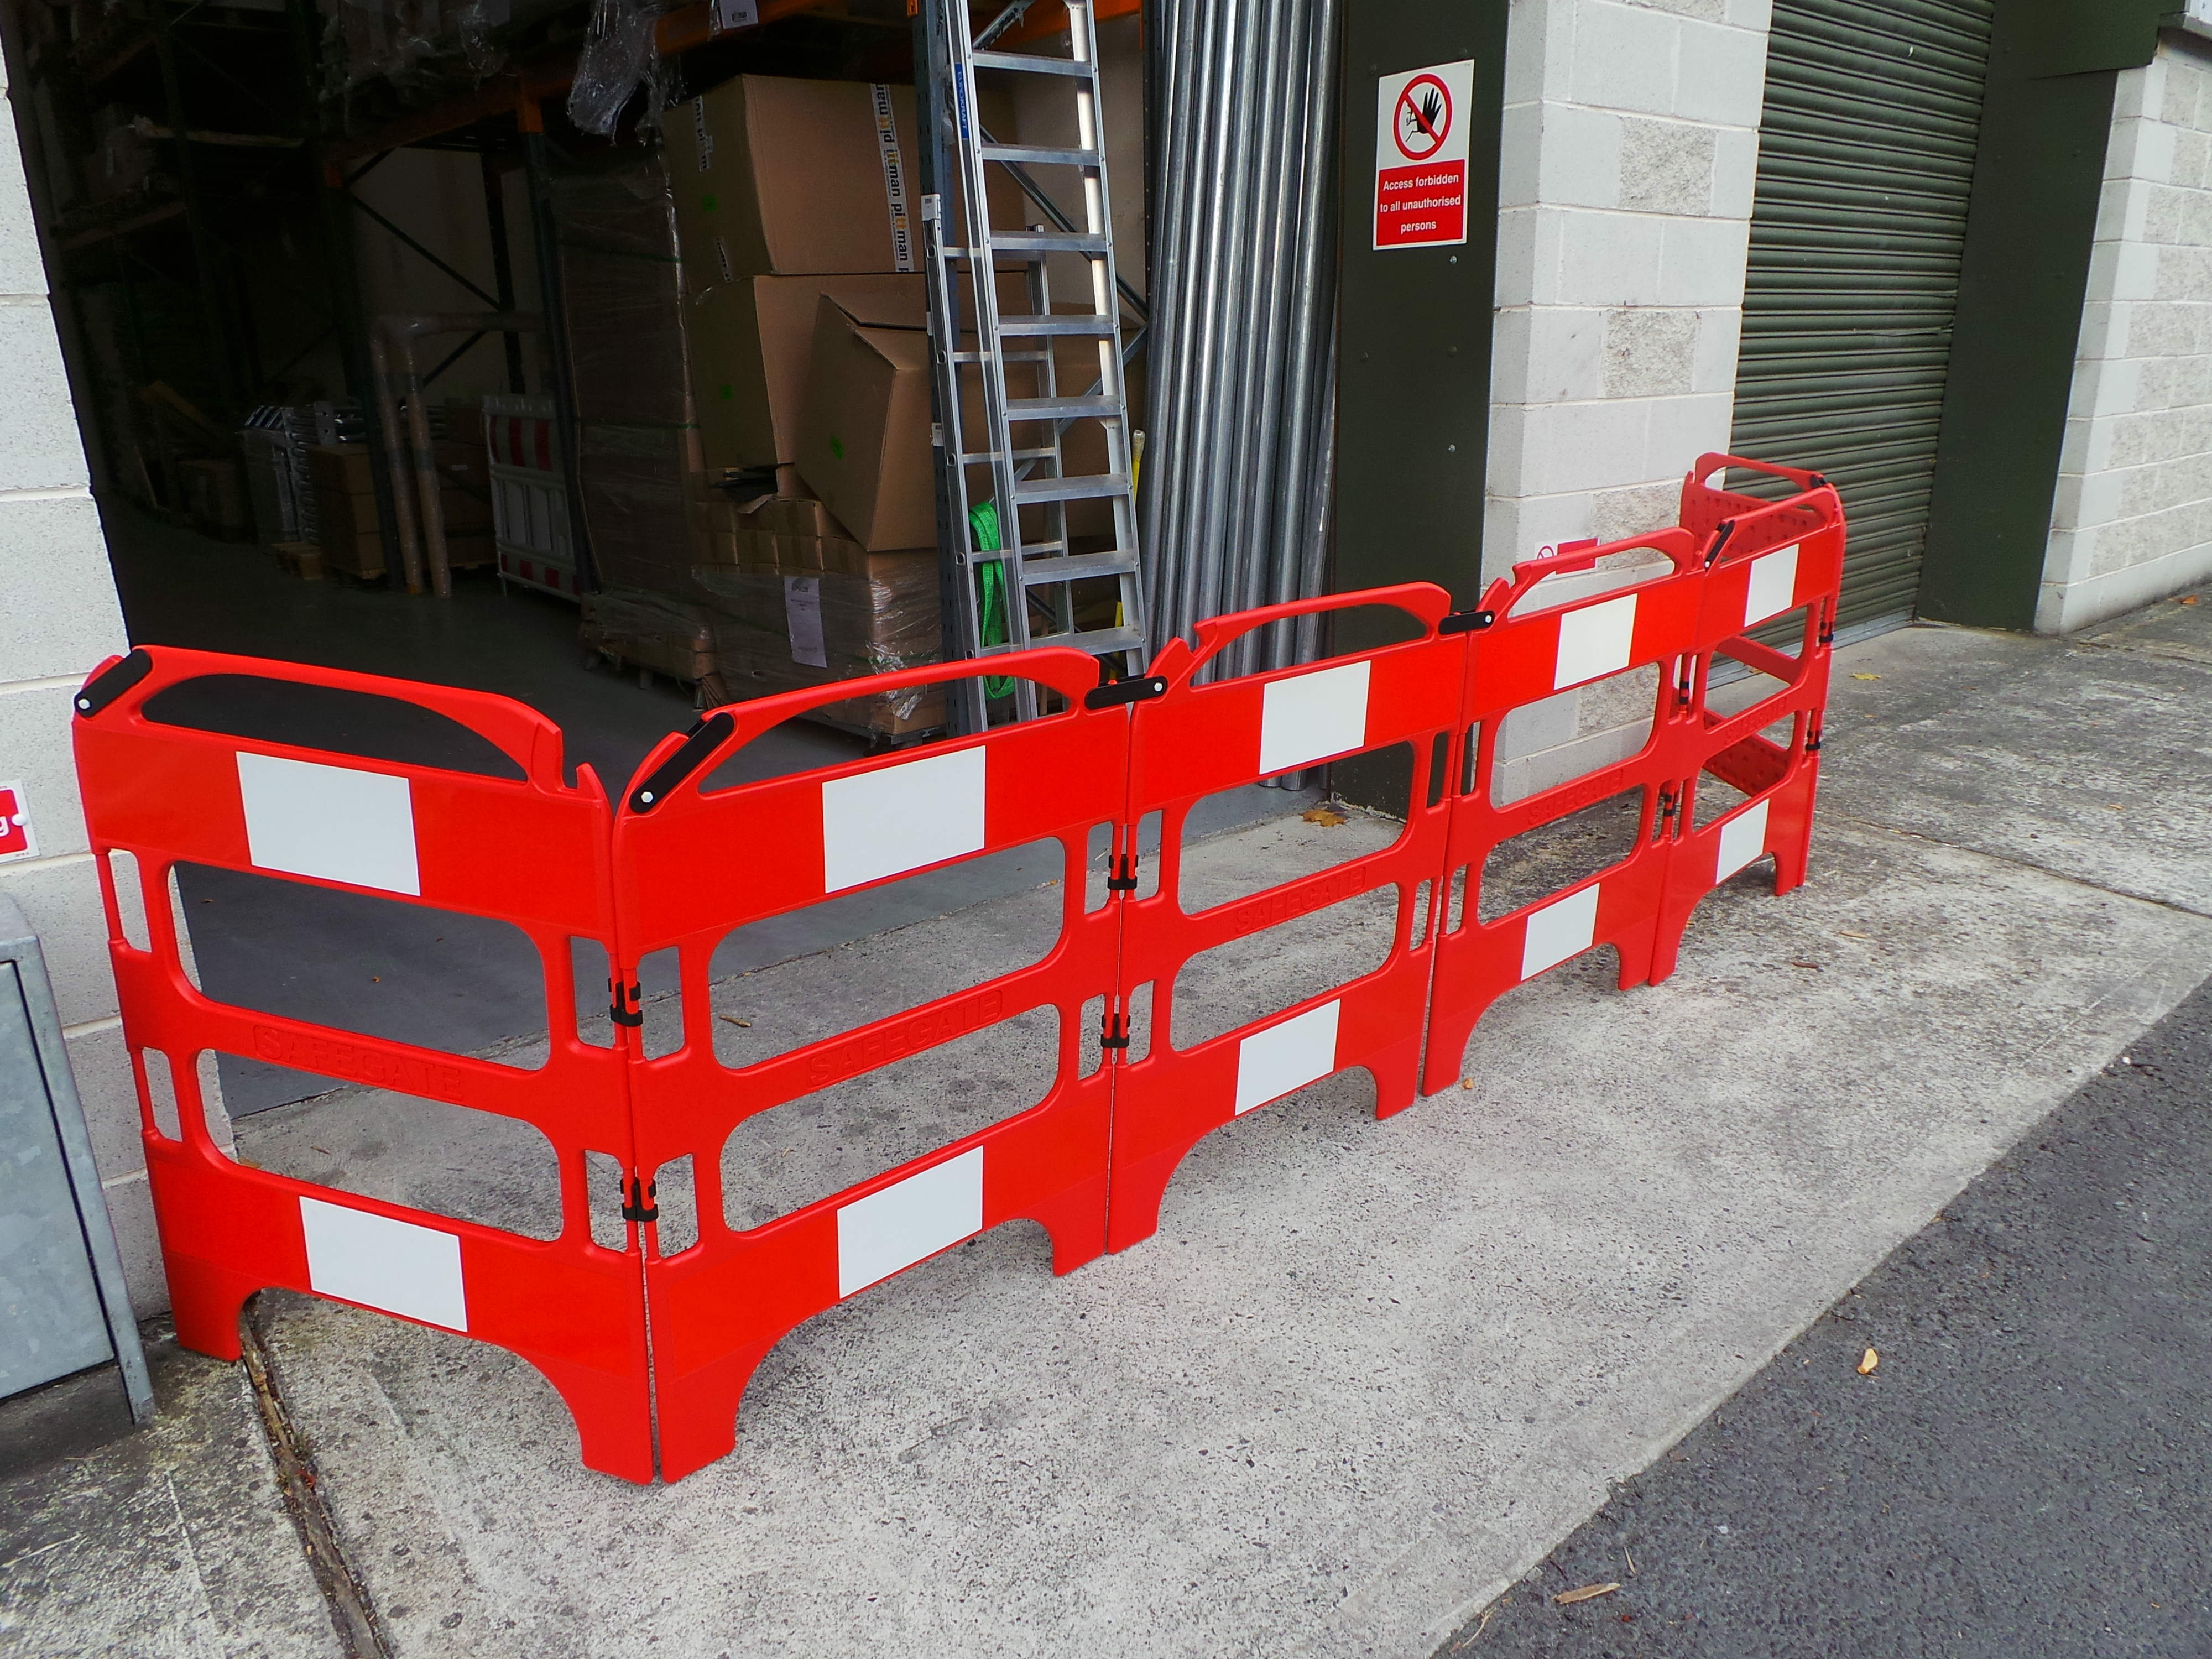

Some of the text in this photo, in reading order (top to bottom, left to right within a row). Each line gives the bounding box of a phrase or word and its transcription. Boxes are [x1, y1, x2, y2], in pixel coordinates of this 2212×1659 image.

[957, 71, 968, 128] EUROKRAFT
[886, 150, 900, 196] ittman
[1383, 173, 1459, 191] Access forbidden
[1380, 194, 1462, 213] to all unauthorised
[1400, 221, 1437, 235] persons
[891, 204, 908, 261] pittman
[1236, 868, 1365, 933] SAFEGATE
[259, 1027, 463, 1102] SAFEGATE
[808, 993, 999, 1085] SAFEGATE
